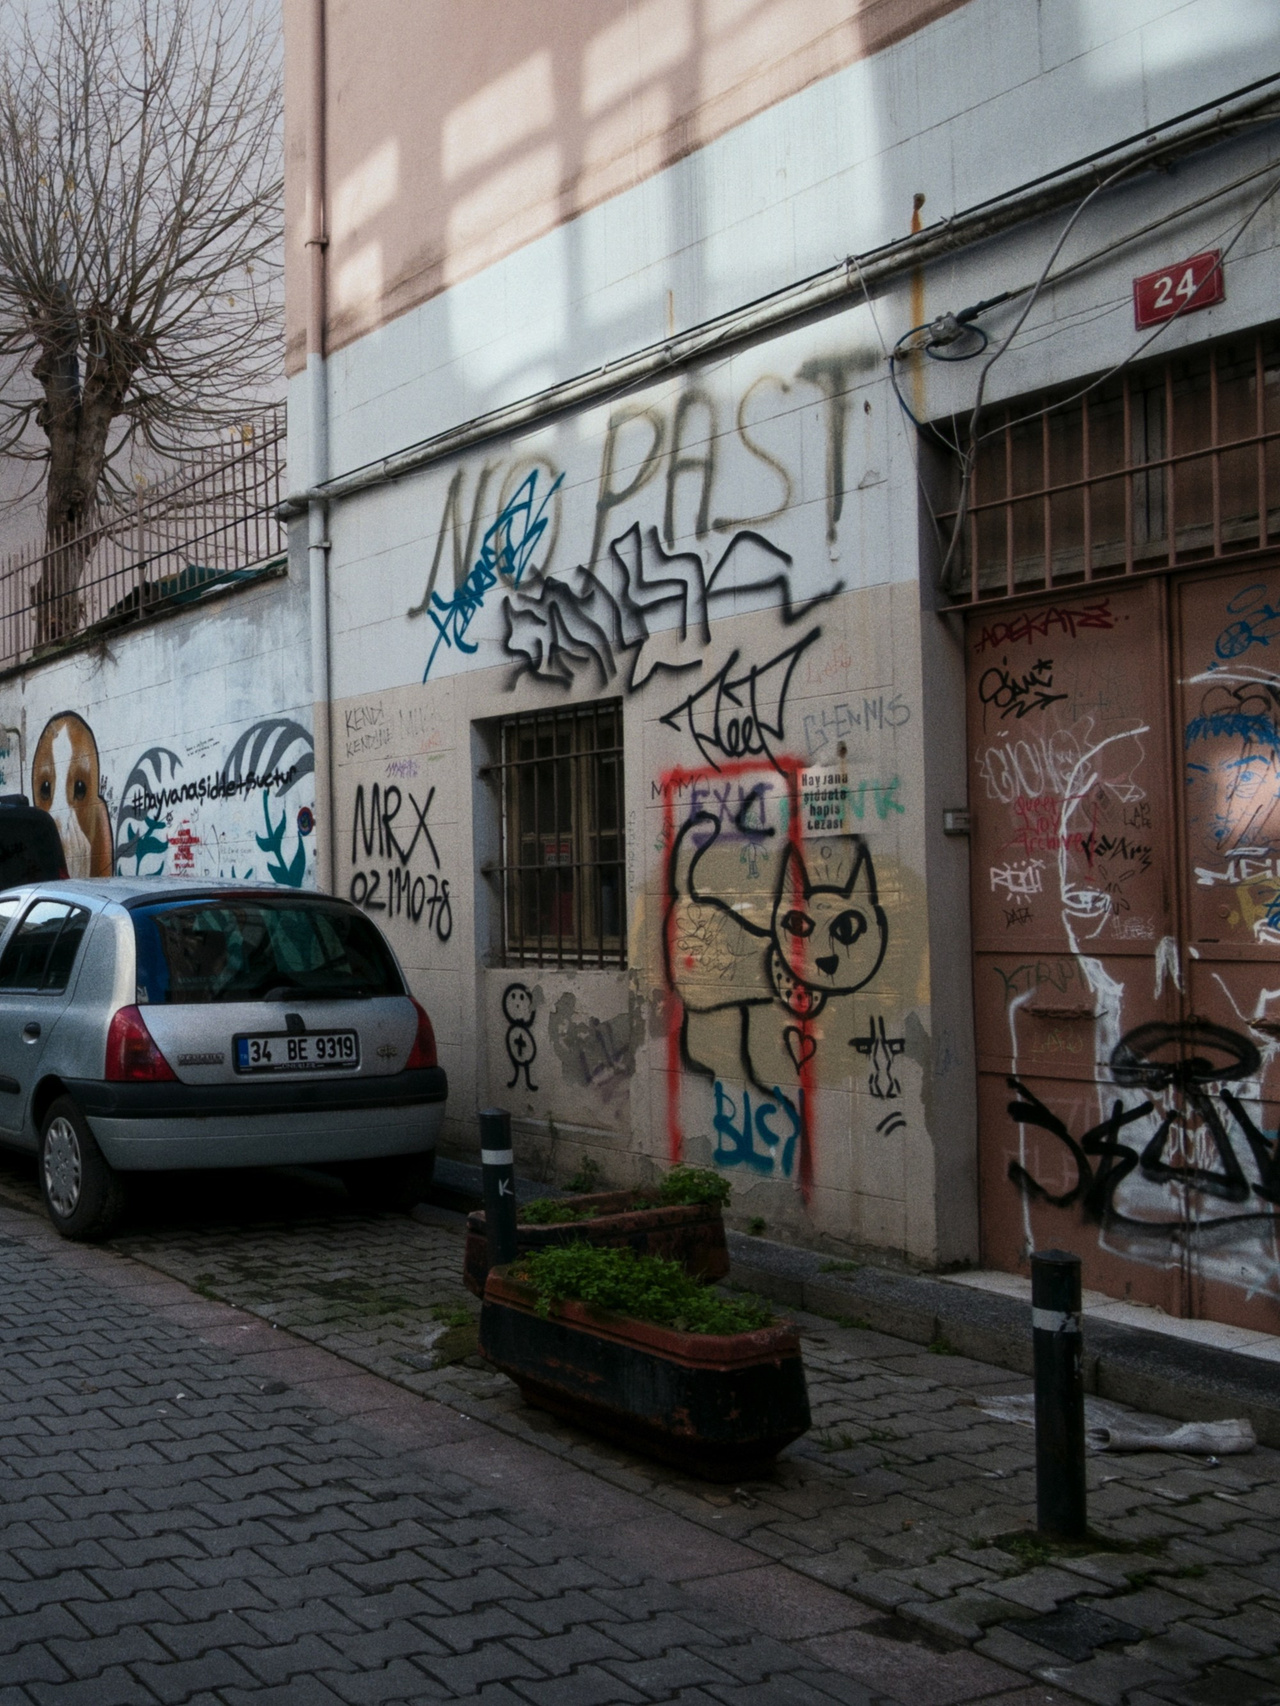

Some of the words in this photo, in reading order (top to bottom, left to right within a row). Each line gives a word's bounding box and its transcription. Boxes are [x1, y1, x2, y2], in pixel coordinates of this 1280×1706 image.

[1153, 269, 1197, 309] 24
[407, 455, 561, 620] NO
[353, 782, 440, 869] MRX
[810, 804, 840, 818] hapis
[250, 1041, 272, 1062] 34
[288, 1039, 308, 1060] BE
[316, 1036, 353, 1059] 9319
